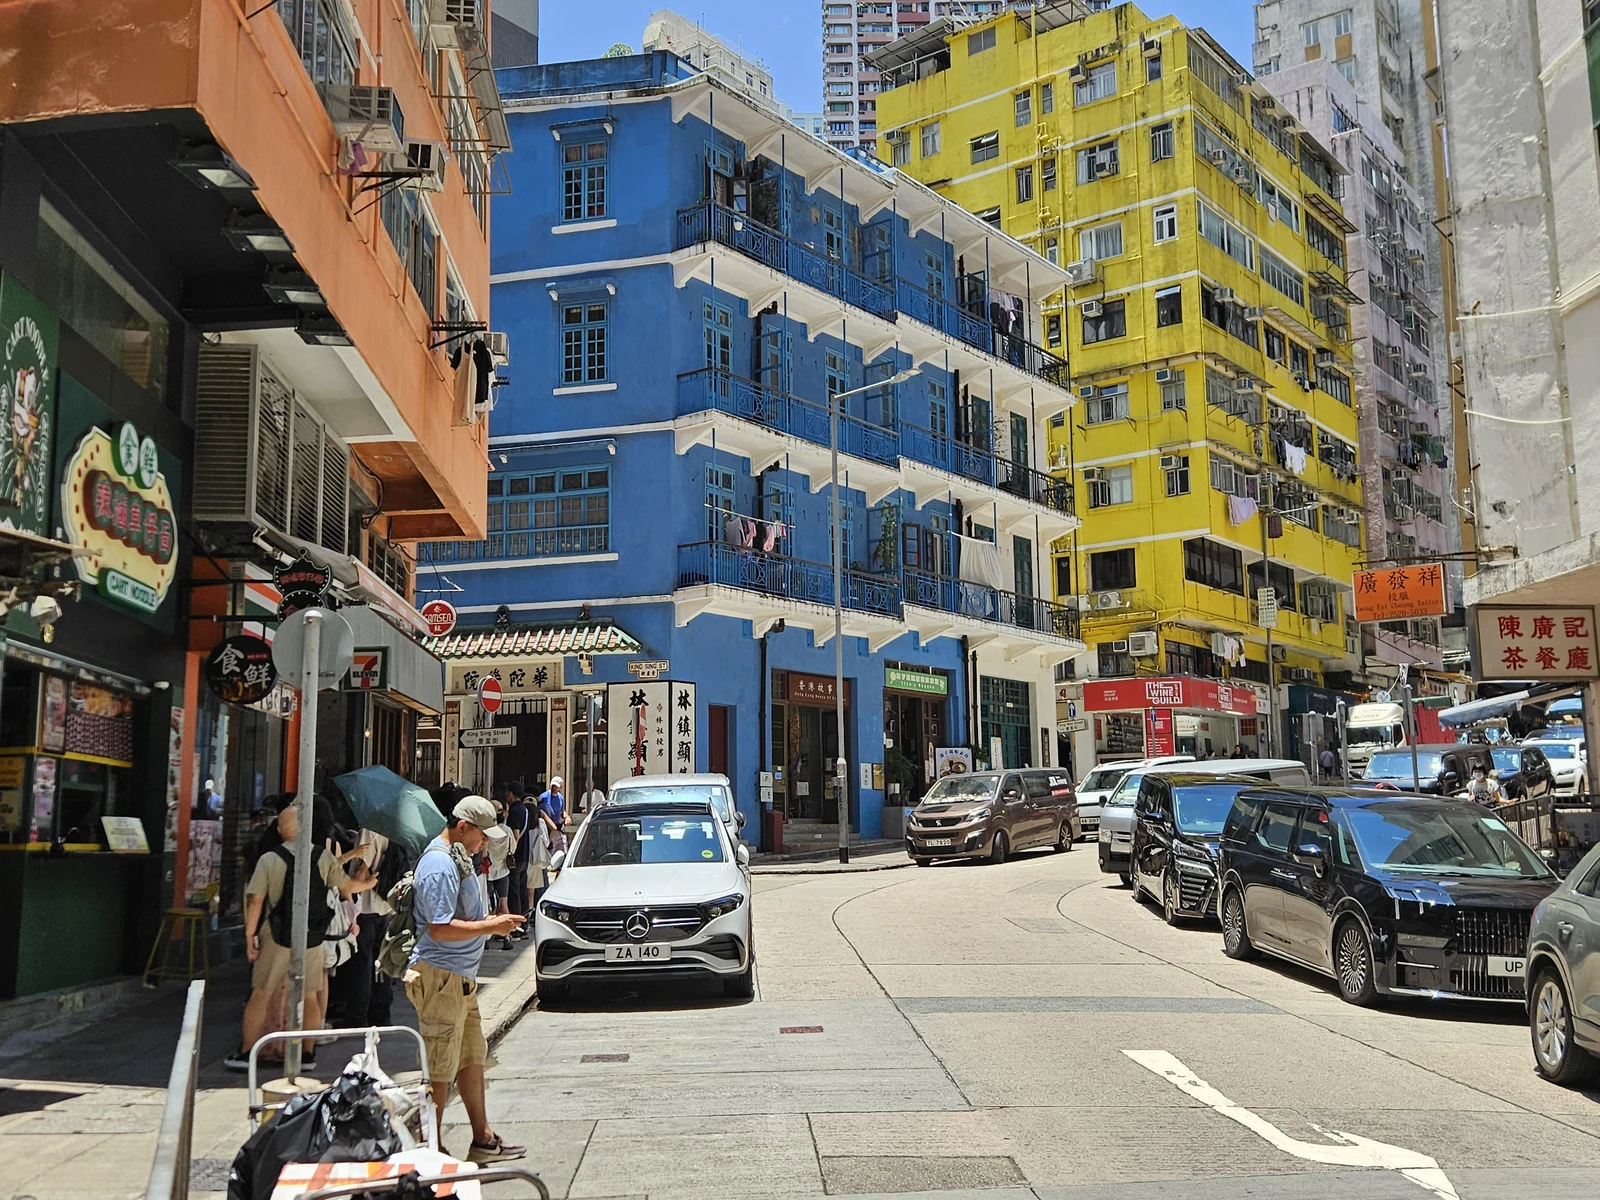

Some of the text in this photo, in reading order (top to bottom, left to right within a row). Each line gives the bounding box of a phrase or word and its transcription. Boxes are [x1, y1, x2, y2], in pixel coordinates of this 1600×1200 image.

[1358, 566, 1440, 594] 廣發祥
[110, 575, 157, 608] CART NOODLE
[1376, 603, 1387, 611] Fat
[1498, 615, 1589, 639] 陳廣記
[1501, 646, 1592, 671] 茶餐廳
[213, 644, 272, 689] 食鮮
[1150, 689, 1174, 697] WINE
[1152, 697, 1180, 705] GUILD
[466, 729, 479, 738] King
[480, 729, 492, 737] Sing
[616, 946, 659, 958] ZA 140
[1505, 960, 1524, 972] UP
